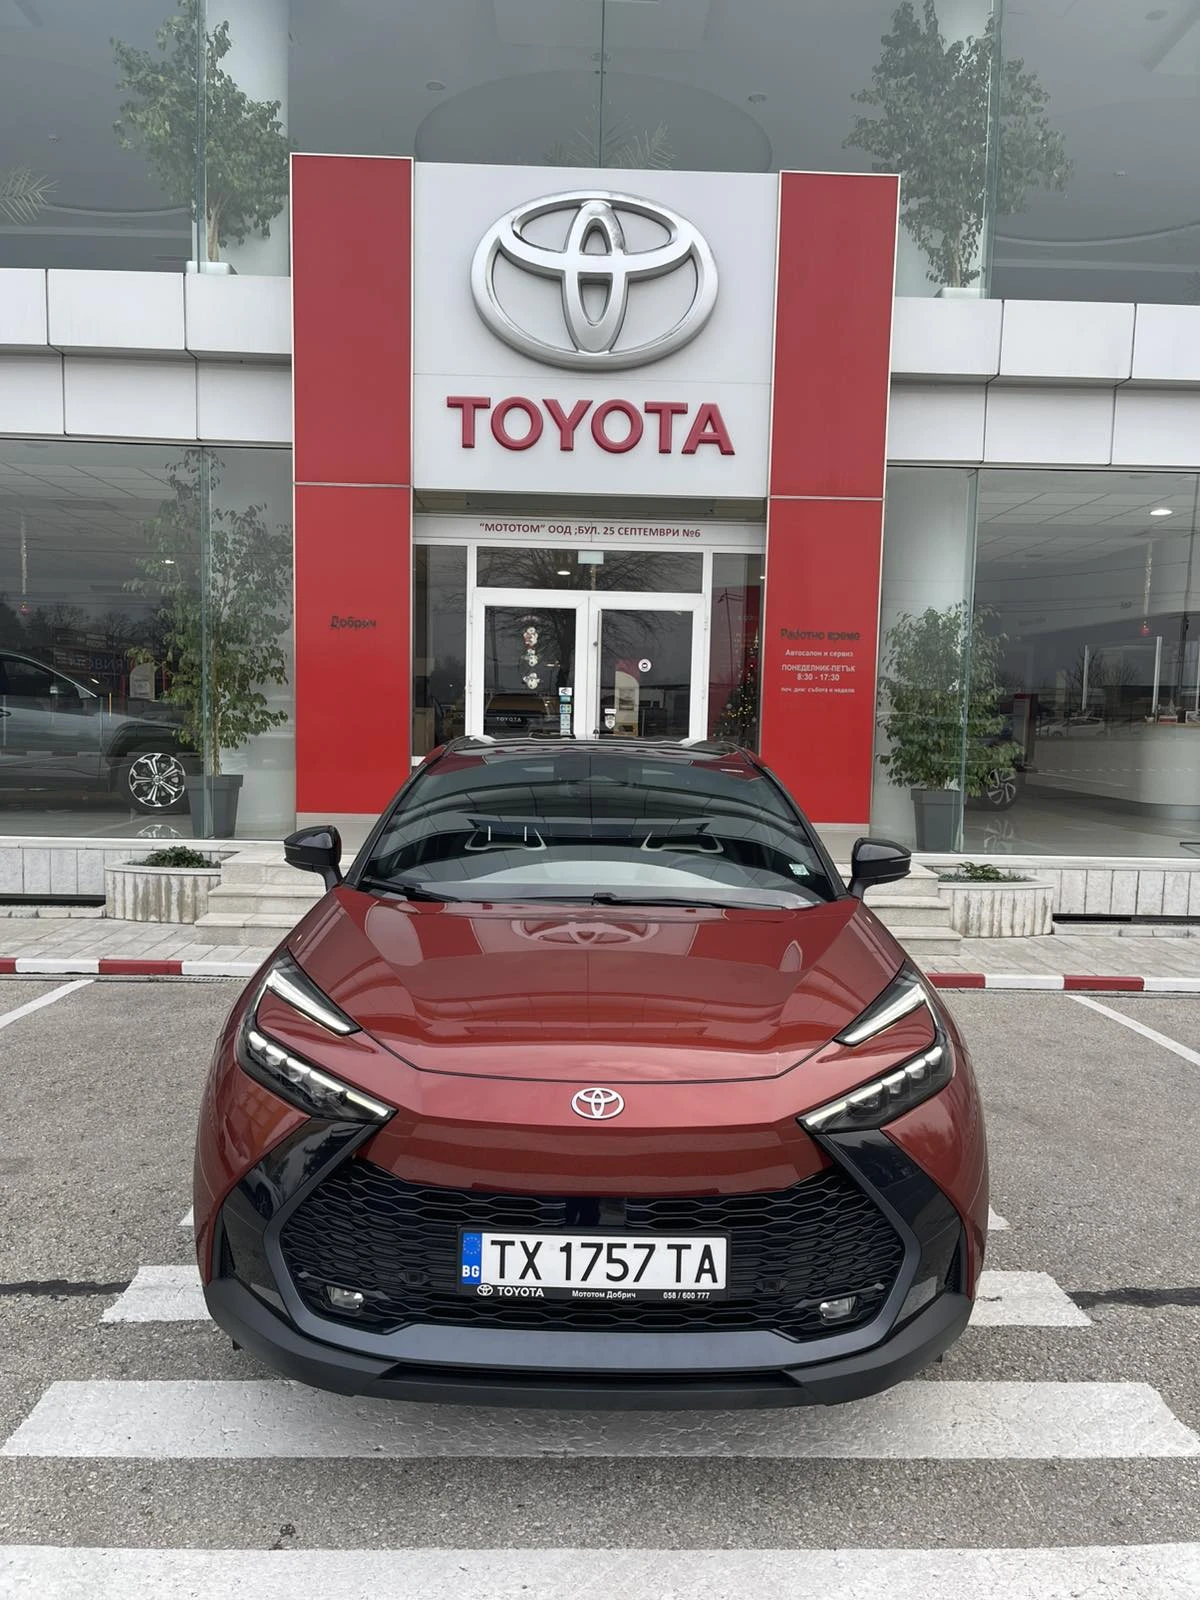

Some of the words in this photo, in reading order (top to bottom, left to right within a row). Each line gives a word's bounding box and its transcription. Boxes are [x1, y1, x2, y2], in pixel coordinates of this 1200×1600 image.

[446, 395, 736, 456] TOYOTA
[547, 524, 572, 537] ООД
[603, 526, 615, 536] 25
[617, 526, 680, 538] СЕПТЕМВРИ
[682, 528, 701, 539] №6
[330, 615, 376, 630] Добрич
[780, 628, 825, 640] Работно
[785, 649, 822, 657] Автосалон
[781, 664, 855, 672] ПОНЕДЕЛНИК-ПЕТЪК
[490, 1239, 543, 1281] TX
[559, 1241, 656, 1283] 1757
[666, 1243, 718, 1284] TA
[462, 1265, 480, 1278] BG
[497, 1286, 544, 1298] TOYOTA
[571, 1289, 606, 1299] Мототом
[606, 1290, 636, 1300] Добрич
[696, 1291, 711, 1300] 777
